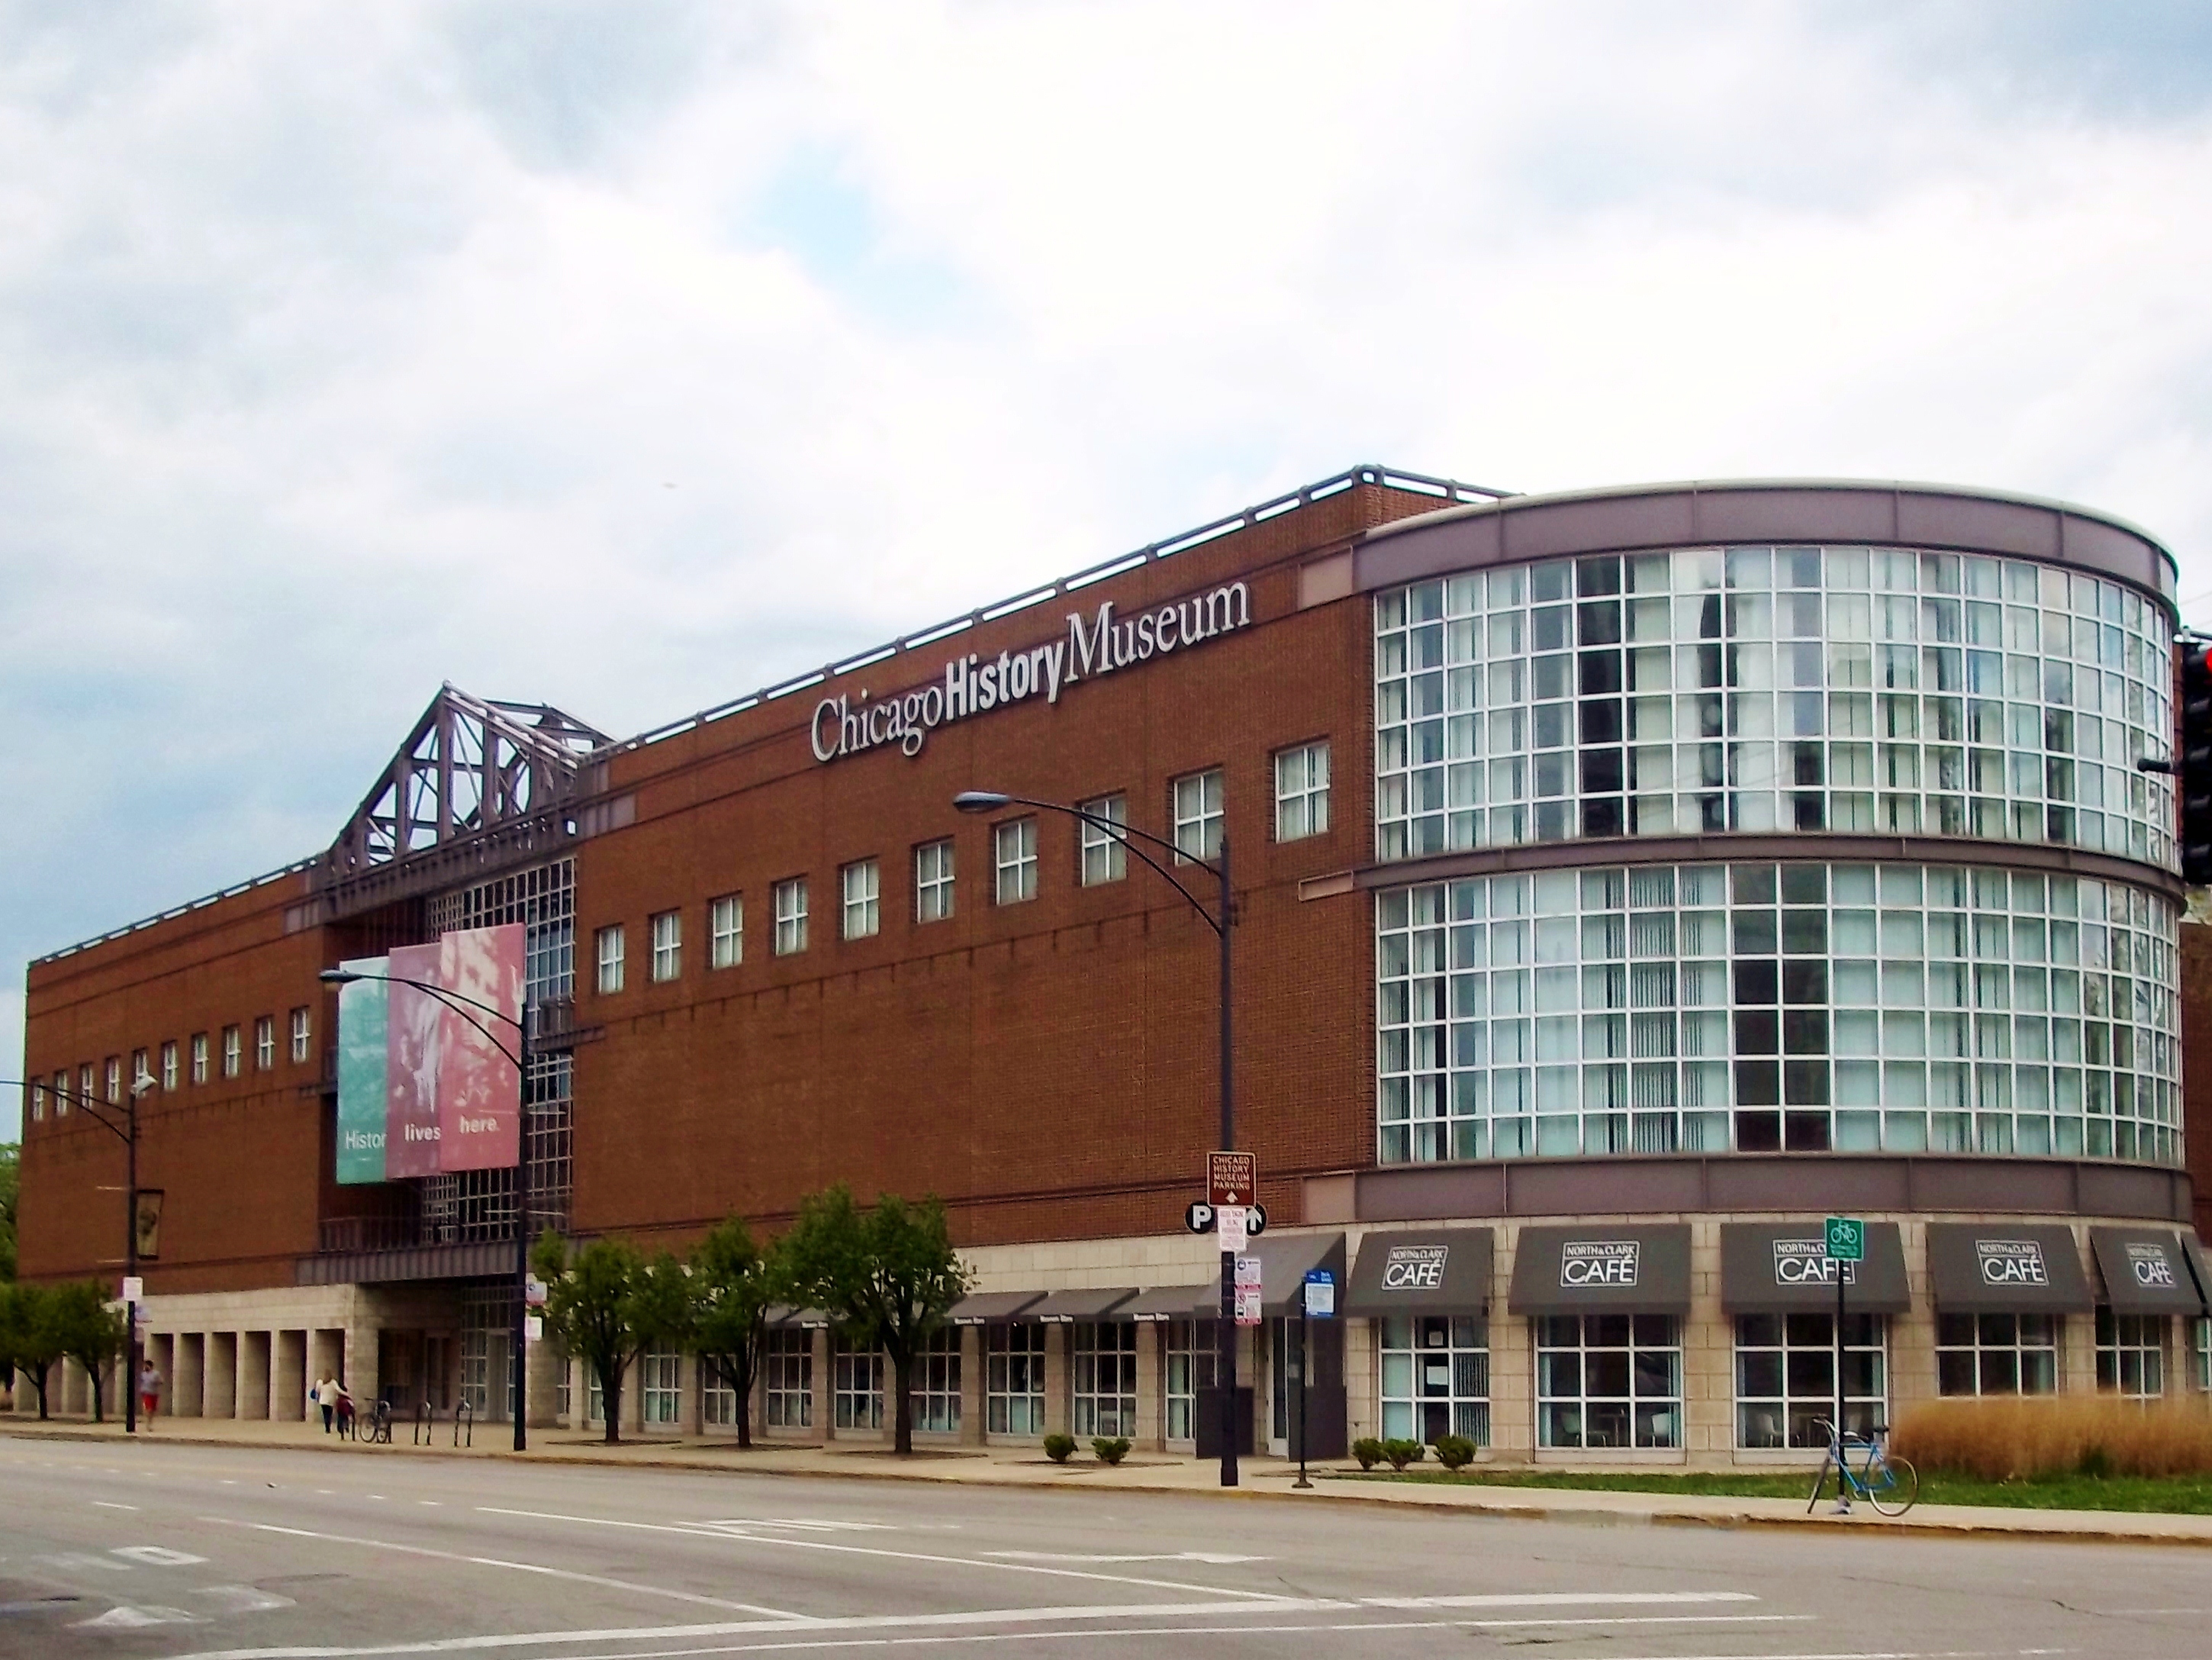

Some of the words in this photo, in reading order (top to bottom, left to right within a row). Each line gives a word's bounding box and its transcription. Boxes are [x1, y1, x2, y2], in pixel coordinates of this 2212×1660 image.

[810, 685, 944, 763] Chicago
[945, 640, 1065, 721] History
[1064, 580, 1251, 684] Museum
[404, 1123, 441, 1142] lives
[345, 1131, 387, 1149] Histor
[1212, 1156, 1250, 1165] CHICAGO
[1212, 1164, 1250, 1173] HISTORY
[1213, 1173, 1250, 1182] MUSEUM
[1212, 1180, 1251, 1191] PARKING
[1193, 1204, 1212, 1230] P
